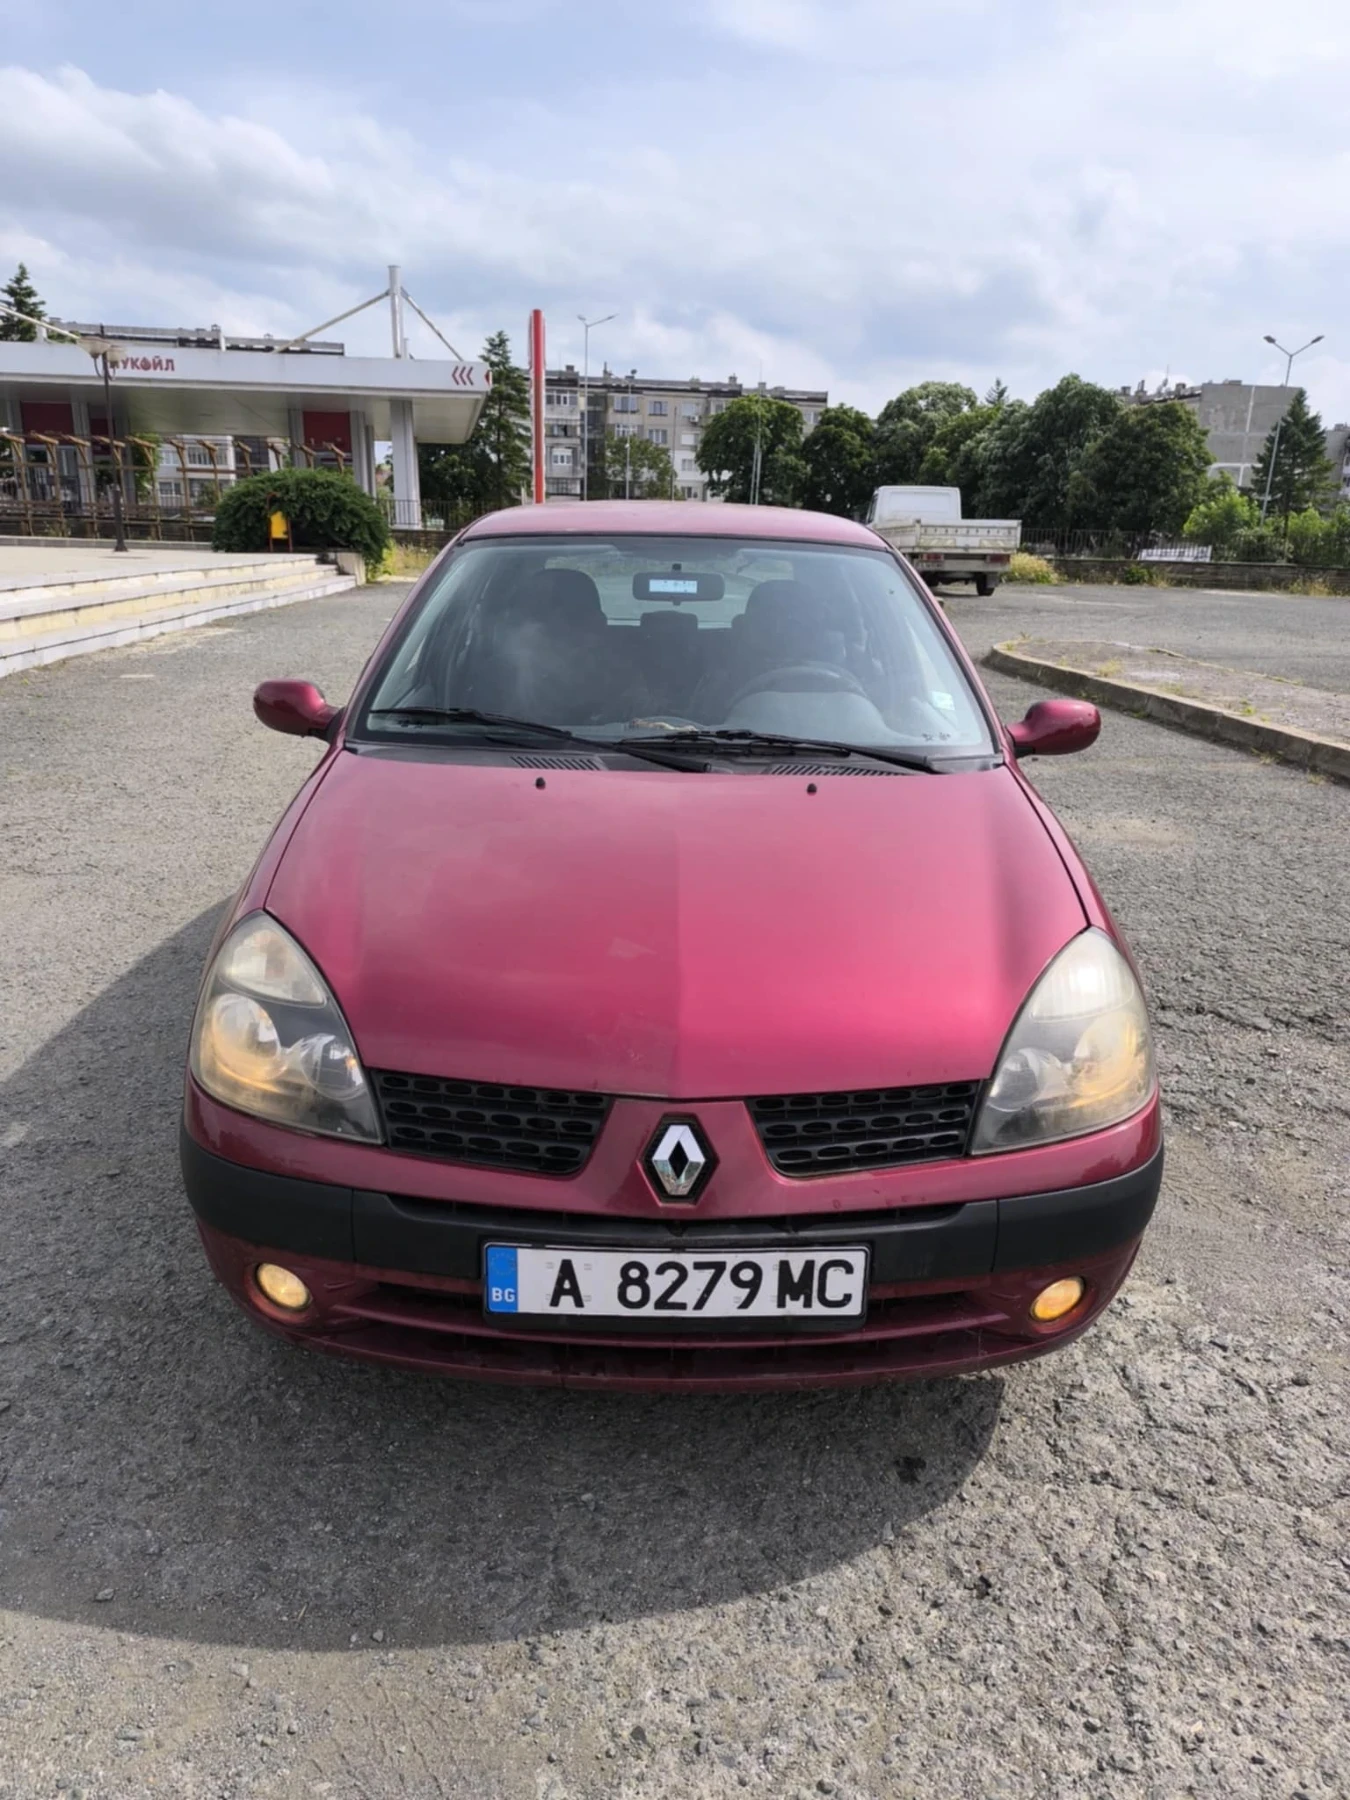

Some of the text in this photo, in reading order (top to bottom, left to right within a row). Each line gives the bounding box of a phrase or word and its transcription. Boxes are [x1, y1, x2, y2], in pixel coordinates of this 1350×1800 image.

[115, 355, 175, 371] УКОЙЛ
[549, 1259, 854, 1311] A 8279 MC
[491, 1287, 516, 1303] BG
